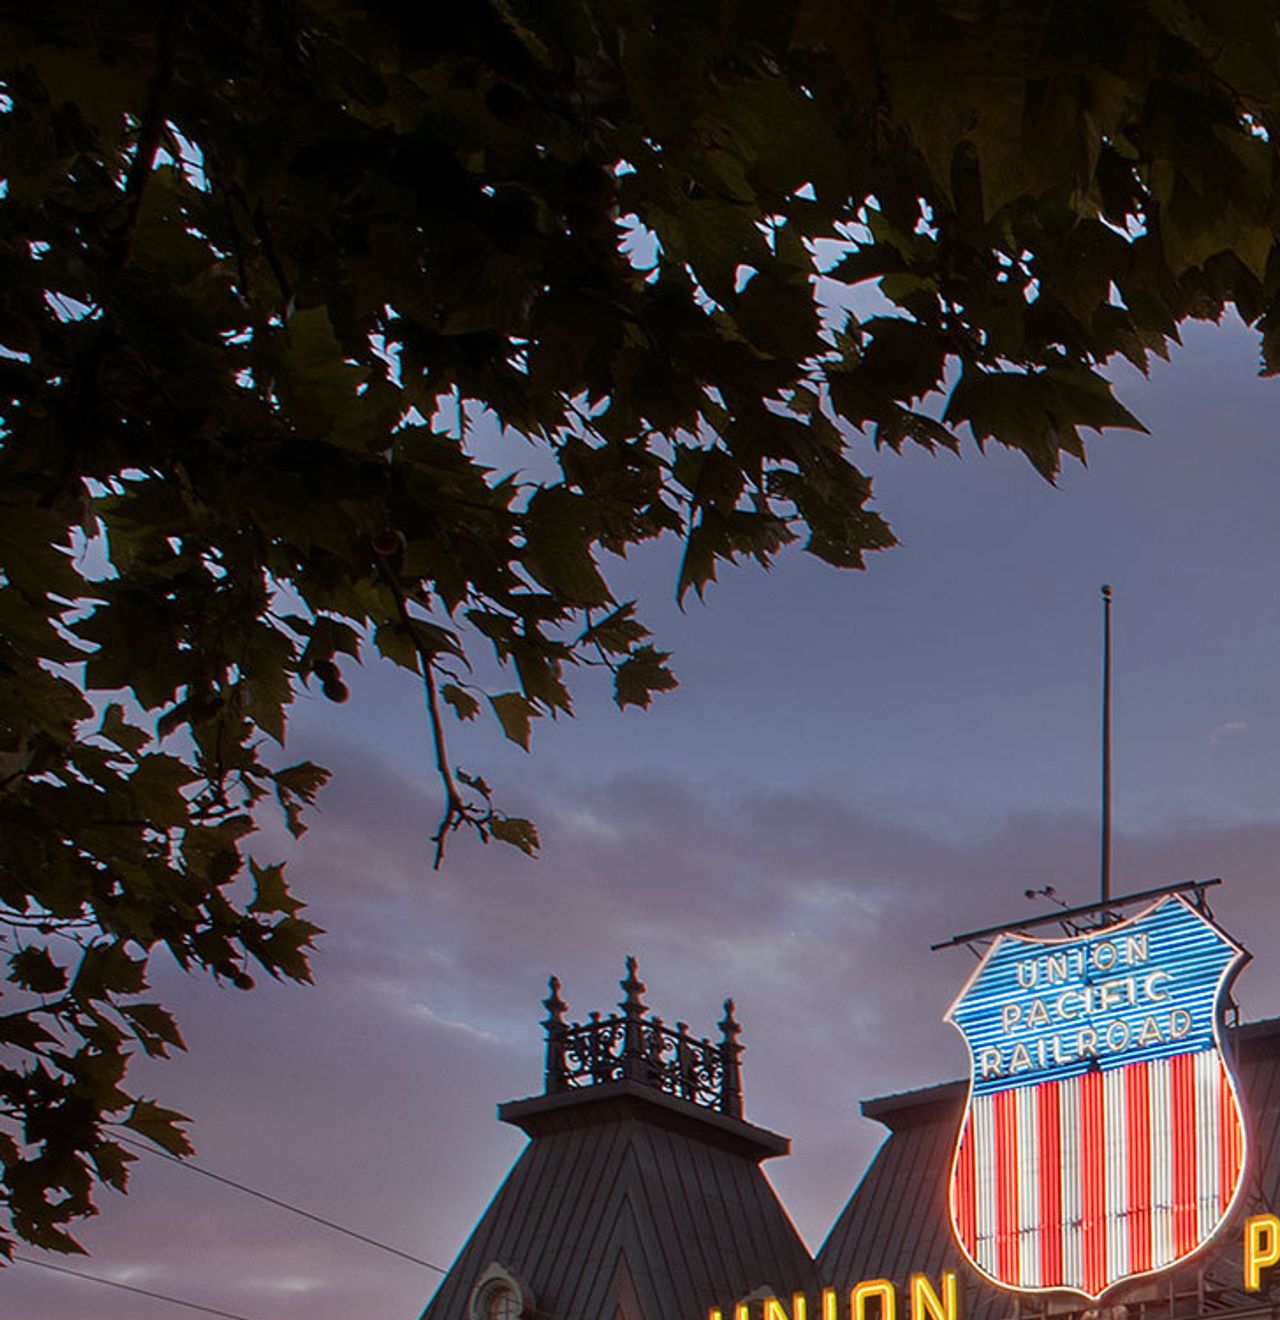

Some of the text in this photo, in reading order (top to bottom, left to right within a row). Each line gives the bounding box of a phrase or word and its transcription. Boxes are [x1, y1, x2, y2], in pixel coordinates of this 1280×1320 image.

[1017, 933, 1150, 988] UNION
[1001, 971, 1174, 1034] PACIFIC
[981, 1010, 1192, 1079] RAILROAD
